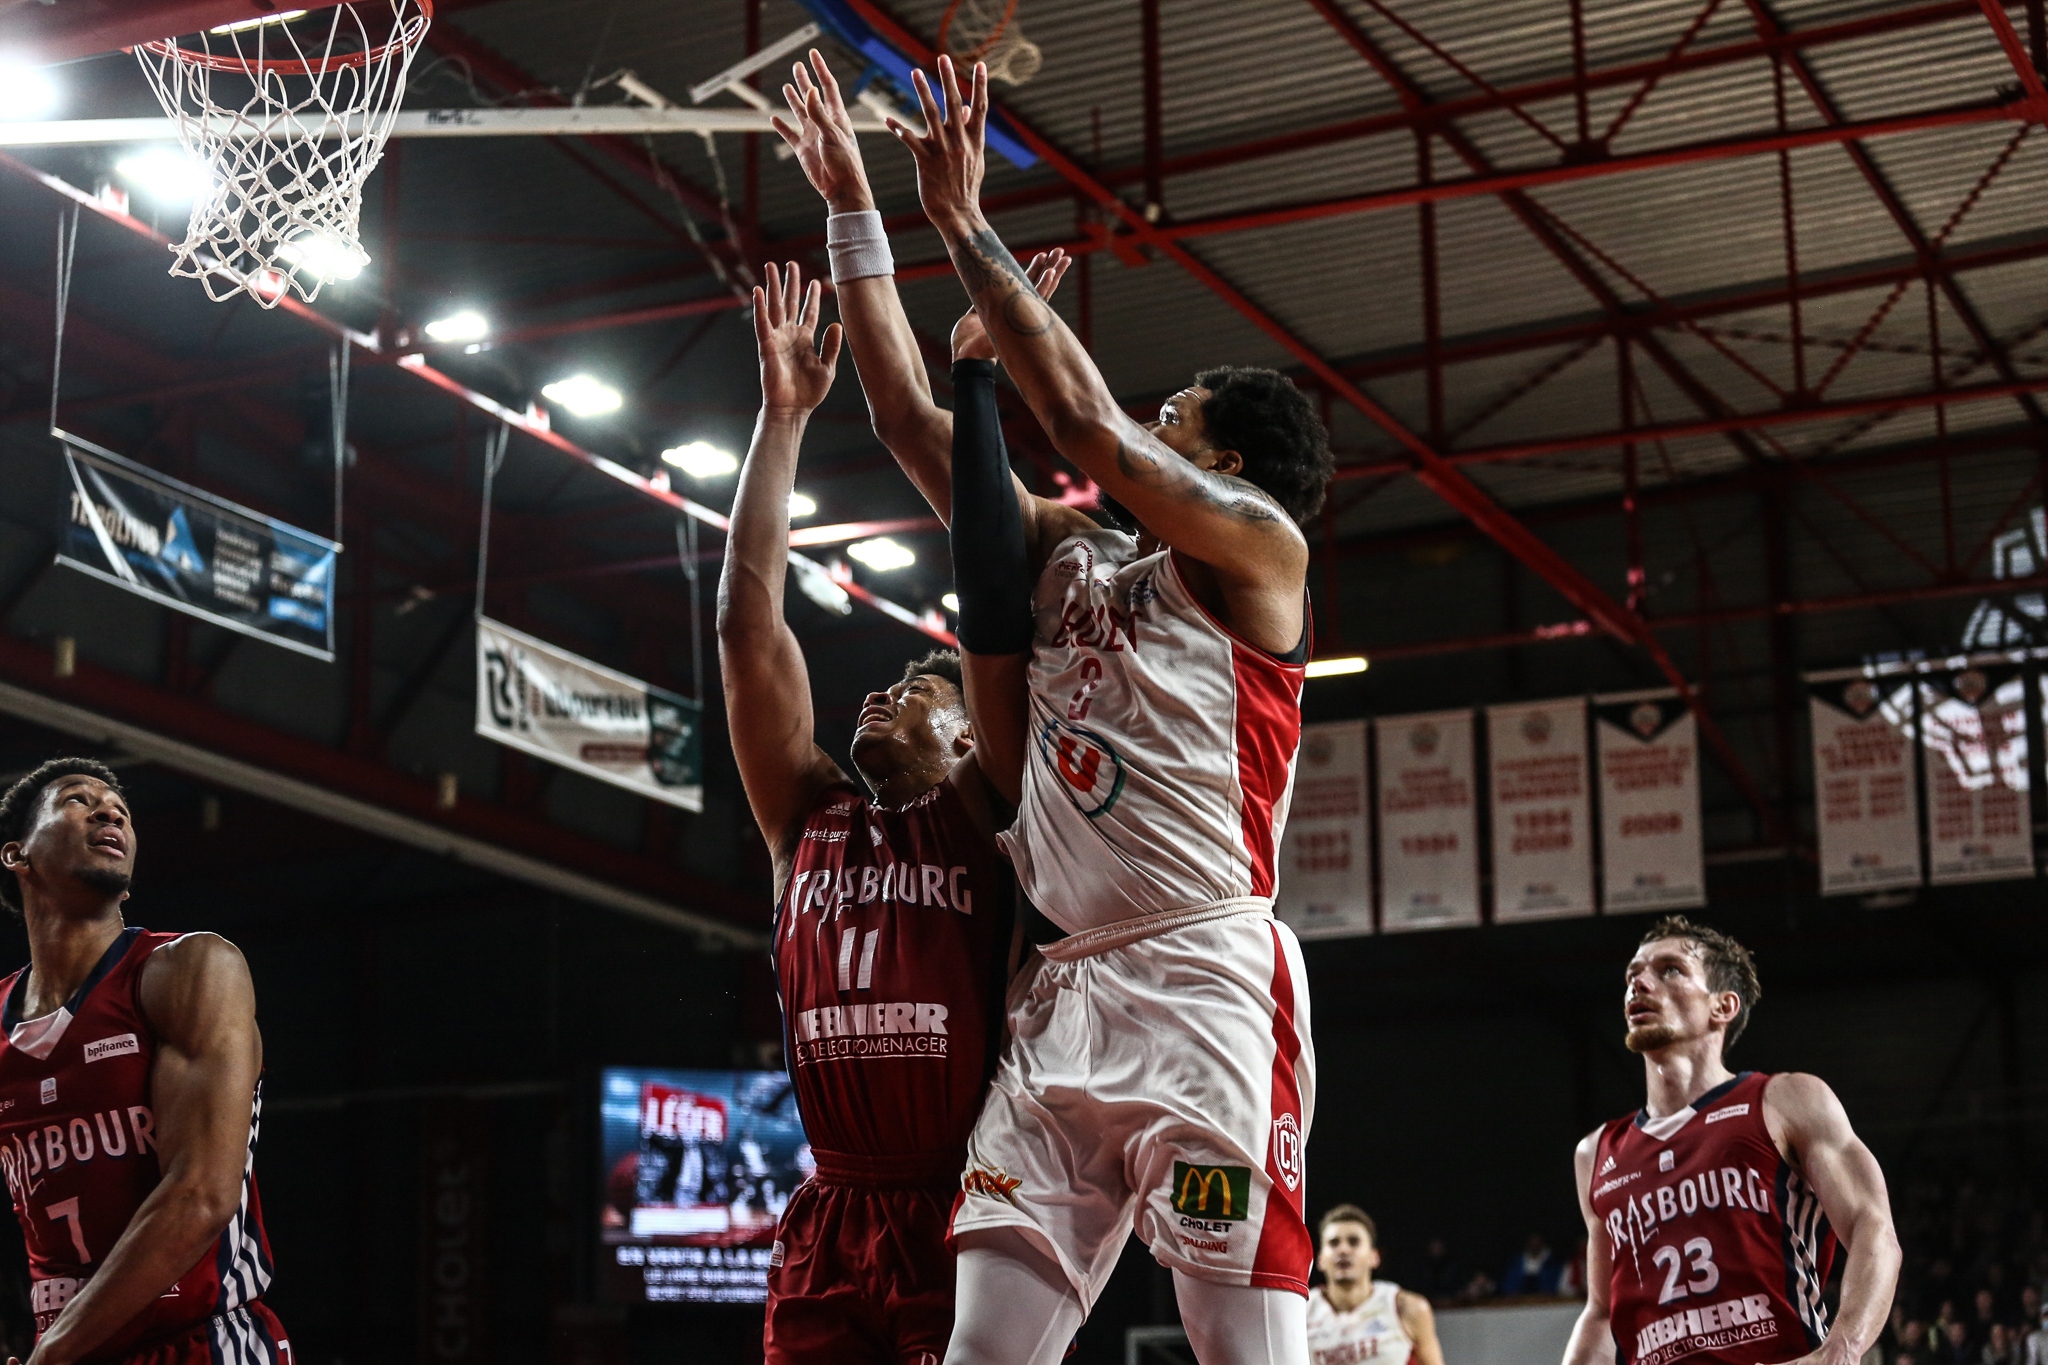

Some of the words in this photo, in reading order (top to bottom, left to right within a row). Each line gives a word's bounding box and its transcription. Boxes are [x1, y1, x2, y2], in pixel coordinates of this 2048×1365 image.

[838, 927, 879, 991] 11
[87, 1038, 135, 1057] bpifrance
[1280, 1129, 1298, 1174] CB
[45, 1196, 92, 1265] 7
[1180, 1217, 1232, 1232] CHOLET
[1651, 1235, 1720, 1306] 23
